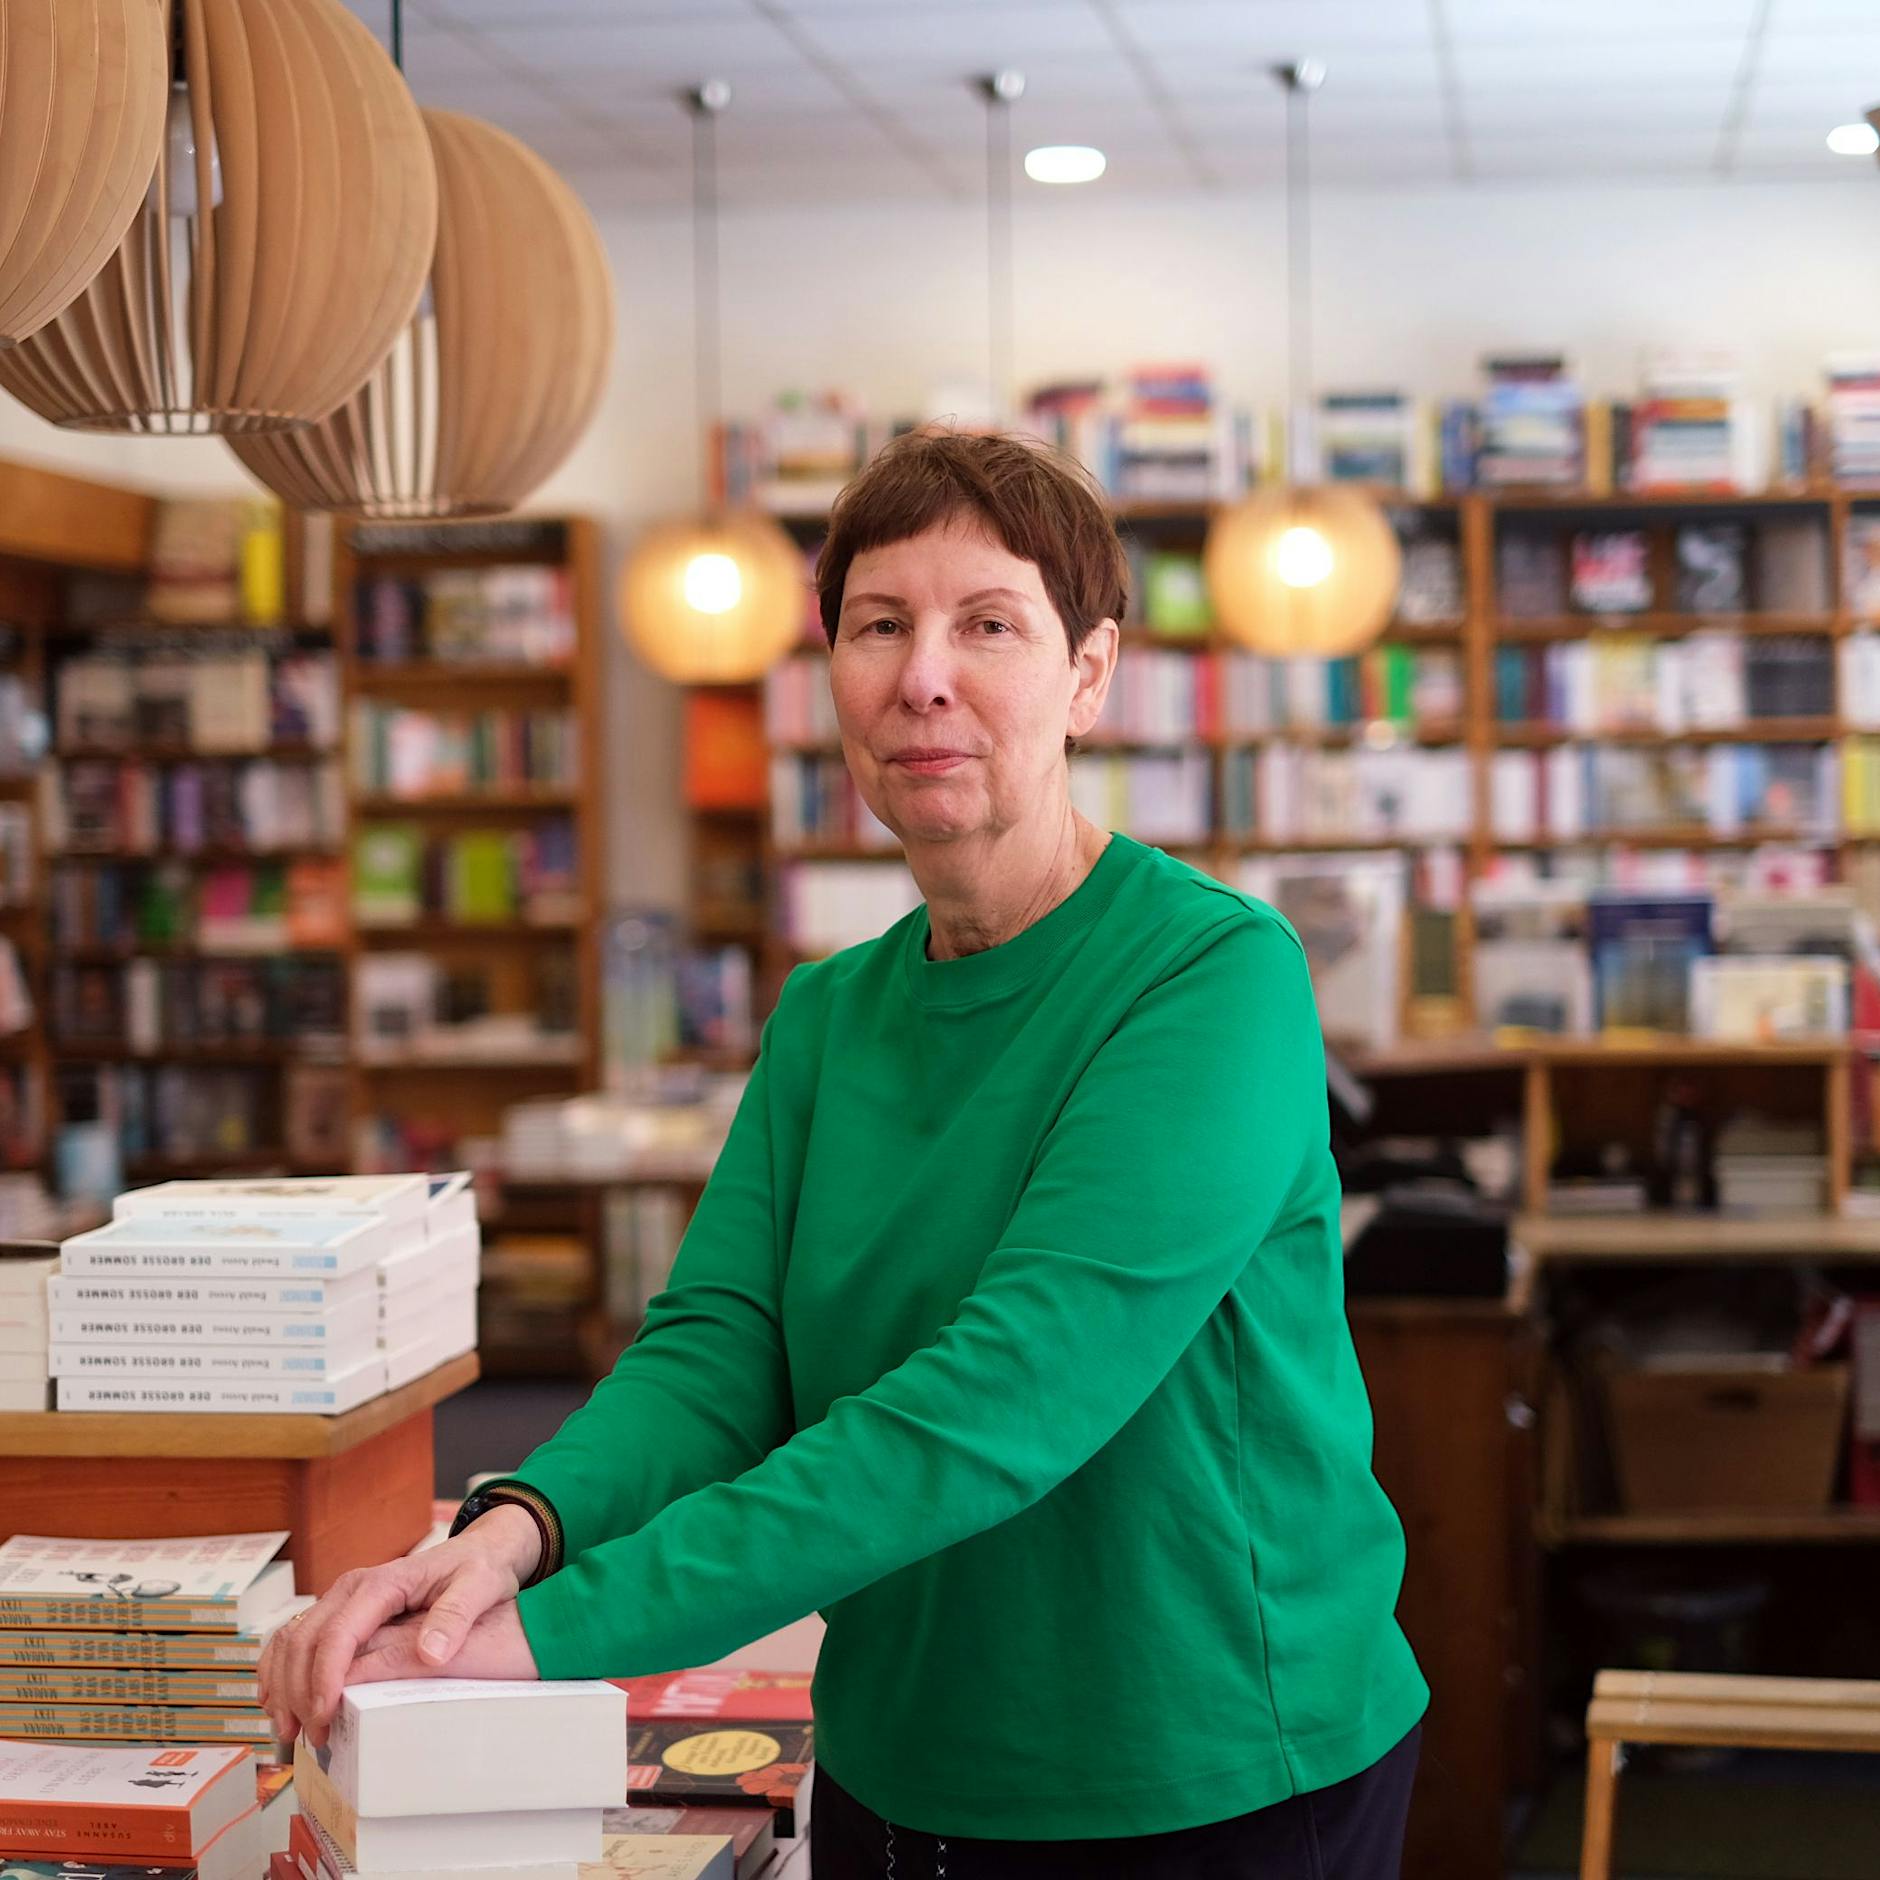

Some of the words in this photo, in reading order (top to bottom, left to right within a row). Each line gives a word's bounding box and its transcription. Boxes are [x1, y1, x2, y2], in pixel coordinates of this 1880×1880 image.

[89, 1256, 137, 1266] SOMMER
[142, 1256, 185, 1266] GROSSE
[189, 1256, 211, 1266] DER
[251, 1257, 280, 1266] Ewald
[76, 1289, 124, 1299] SOMMER
[128, 1289, 172, 1299] GROSSE
[176, 1289, 198, 1299] DER
[237, 1292, 267, 1301] Ewald
[80, 1324, 128, 1334] SOMMER
[132, 1324, 176, 1334] GROSSE
[181, 1324, 202, 1334] DER
[242, 1326, 270, 1336] Ewald
[79, 1357, 126, 1367] SOMMER
[131, 1357, 175, 1367] GROSSE
[179, 1357, 201, 1367] DER
[241, 1359, 270, 1369] Ewald
[88, 1390, 136, 1401] SOMMER
[140, 1390, 184, 1401] GROSSE
[188, 1390, 211, 1401] DER
[251, 1392, 279, 1402] Ewald
[13, 1651, 55, 1663] MARIANA
[16, 1688, 58, 1700] MARIANA
[23, 1723, 65, 1735] MARIANA
[89, 1822, 117, 1830] ABEL
[15, 1827, 41, 1837] AWAY
[42, 1829, 66, 1838] STAY
[77, 1830, 132, 1840] SUSANNE
